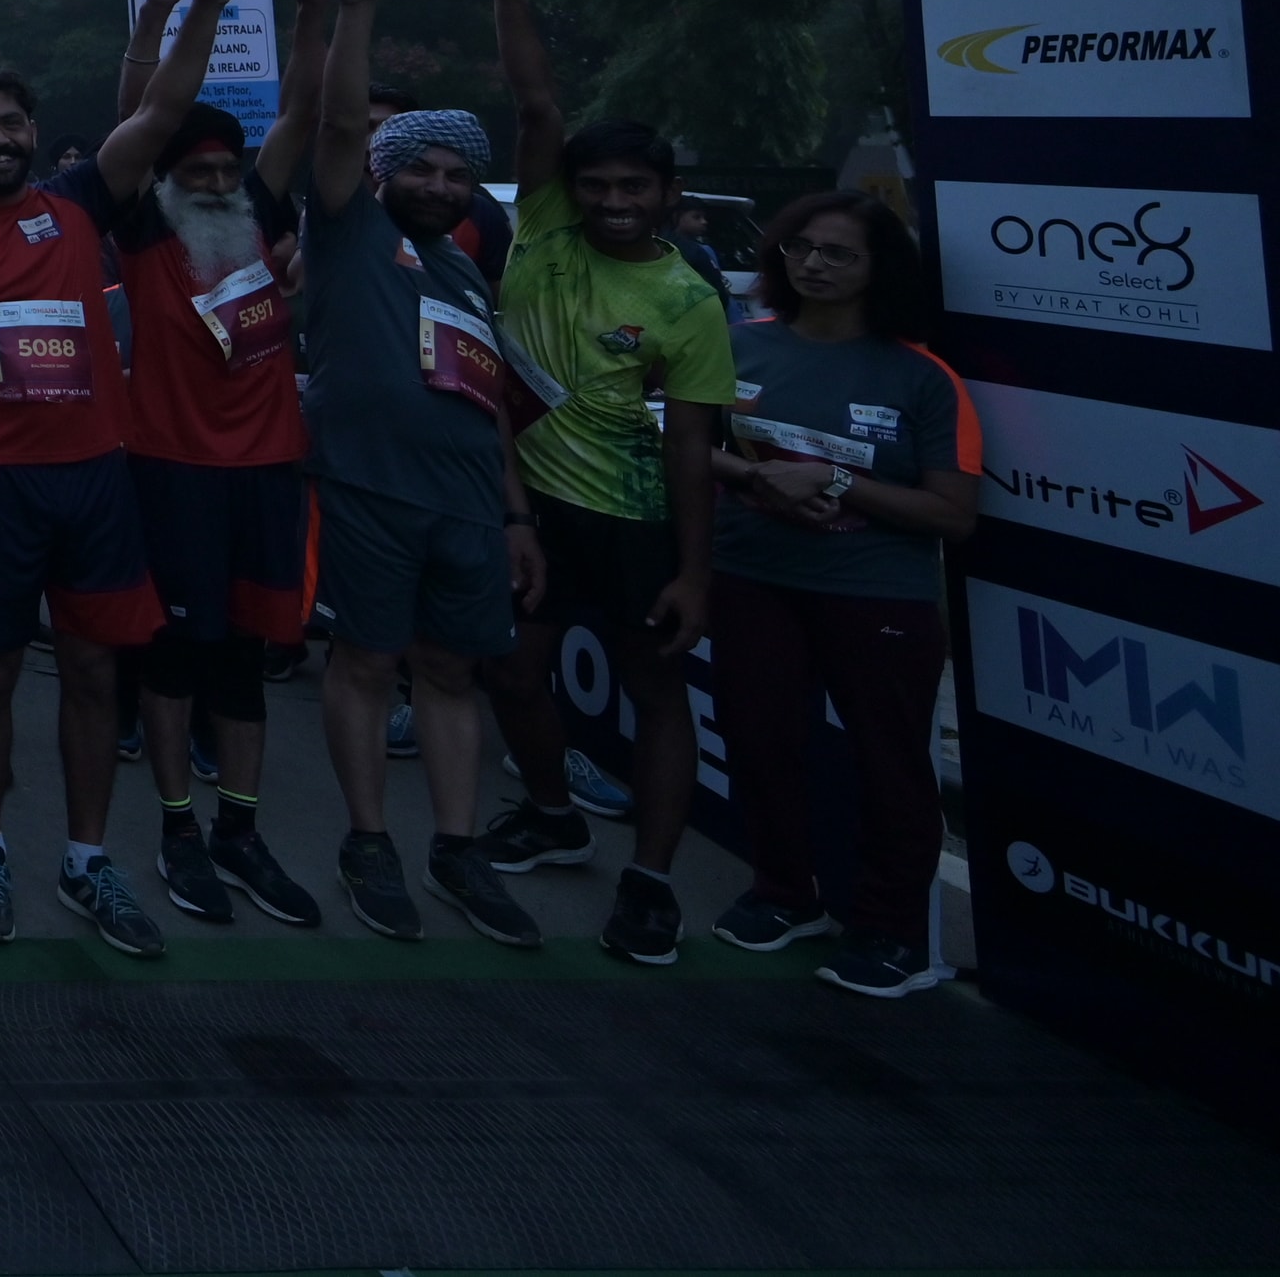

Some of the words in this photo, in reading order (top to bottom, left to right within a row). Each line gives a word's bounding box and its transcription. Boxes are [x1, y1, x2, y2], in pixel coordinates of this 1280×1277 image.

[223, 8, 233, 17] IN
[215, 25, 262, 35] USTRALIA
[213, 44, 250, 54] ALAND,
[1022, 28, 1216, 64] PERFORMAX
[209, 64, 215, 73] &
[218, 62, 260, 72] IRELAND
[214, 86, 224, 96] 1st
[227, 86, 251, 96] Floor,
[233, 99, 265, 107] Market,
[236, 111, 276, 120] Ludhiana
[1099, 271, 1163, 291] Select
[239, 298, 273, 327] 5397
[994, 290, 1018, 304] BY
[1033, 294, 1102, 313] VIRAT
[1119, 304, 1200, 324] KOHLI
[19, 339, 76, 357] 5088
[456, 339, 497, 377] 5427
[780, 430, 824, 445] LUDHIANA
[828, 443, 842, 451] 10K
[846, 447, 866, 457] RUN
[1027, 696, 1032, 714] I
[1049, 704, 1095, 736] AM
[1144, 737, 1149, 754] I
[1168, 748, 1245, 788] WAS
